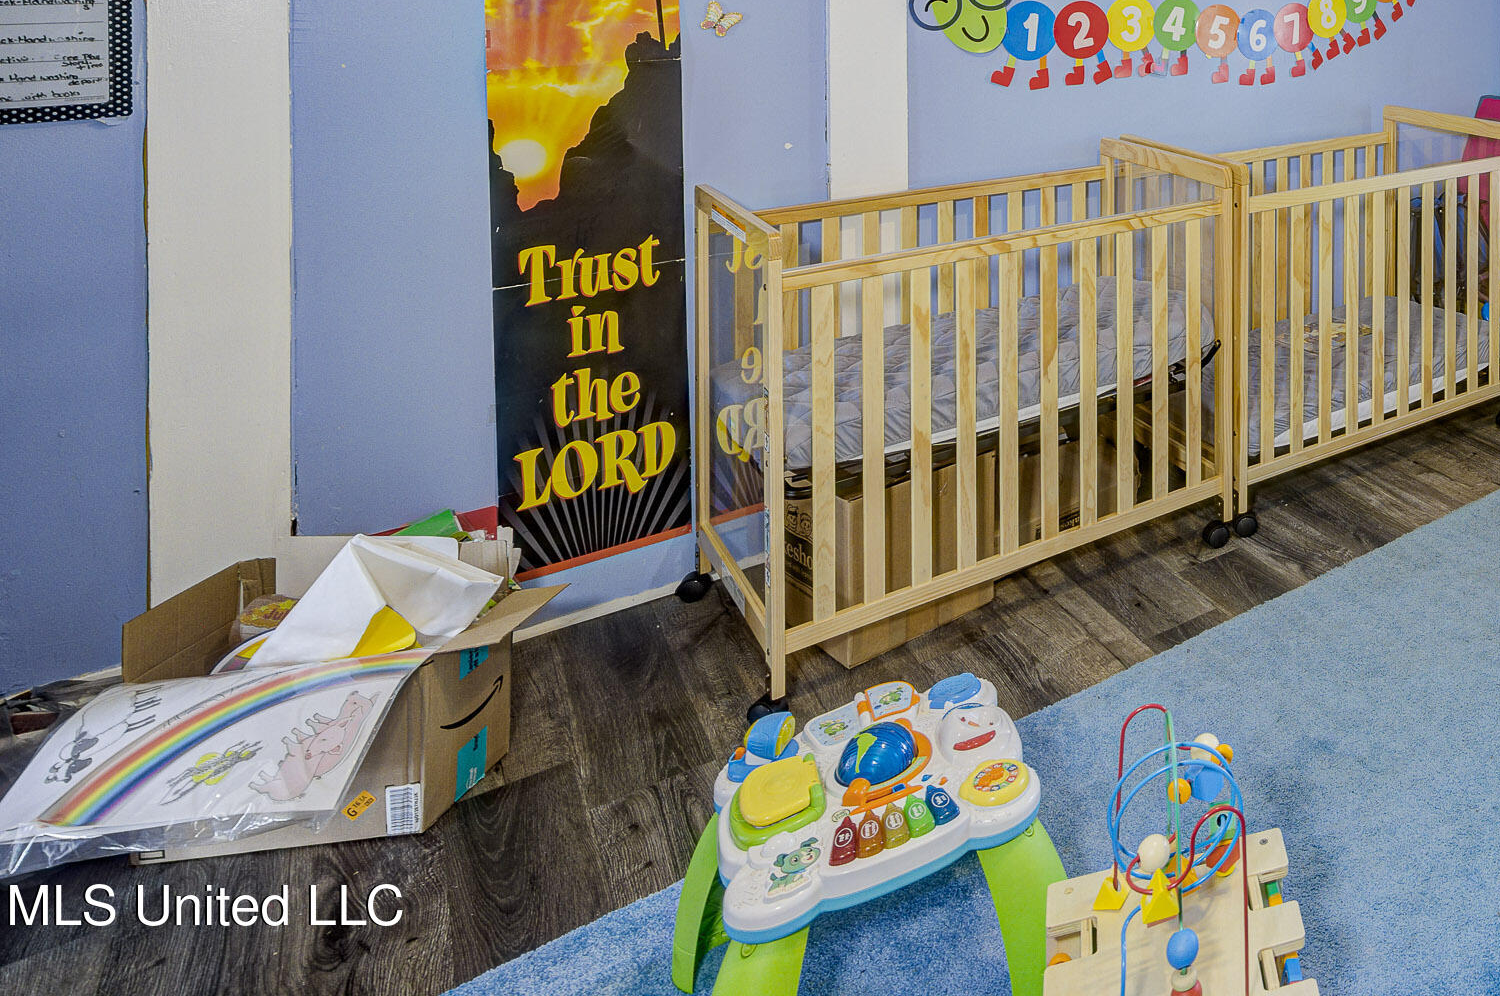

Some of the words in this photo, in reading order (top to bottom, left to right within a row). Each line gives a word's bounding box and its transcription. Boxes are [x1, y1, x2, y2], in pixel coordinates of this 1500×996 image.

[1022, 12, 1040, 51] 1
[1066, 12, 1094, 50] 2
[1121, 5, 1142, 42] 3
[1162, 6, 1187, 41] 4
[1208, 16, 1231, 47] 5
[1249, 20, 1268, 52] 6
[1283, 14, 1301, 44] 7
[518, 234, 660, 307] Trust
[566, 305, 625, 358] in
[551, 367, 641, 428] the
[513, 421, 677, 512] LORD
[347, 807, 358, 817] G
